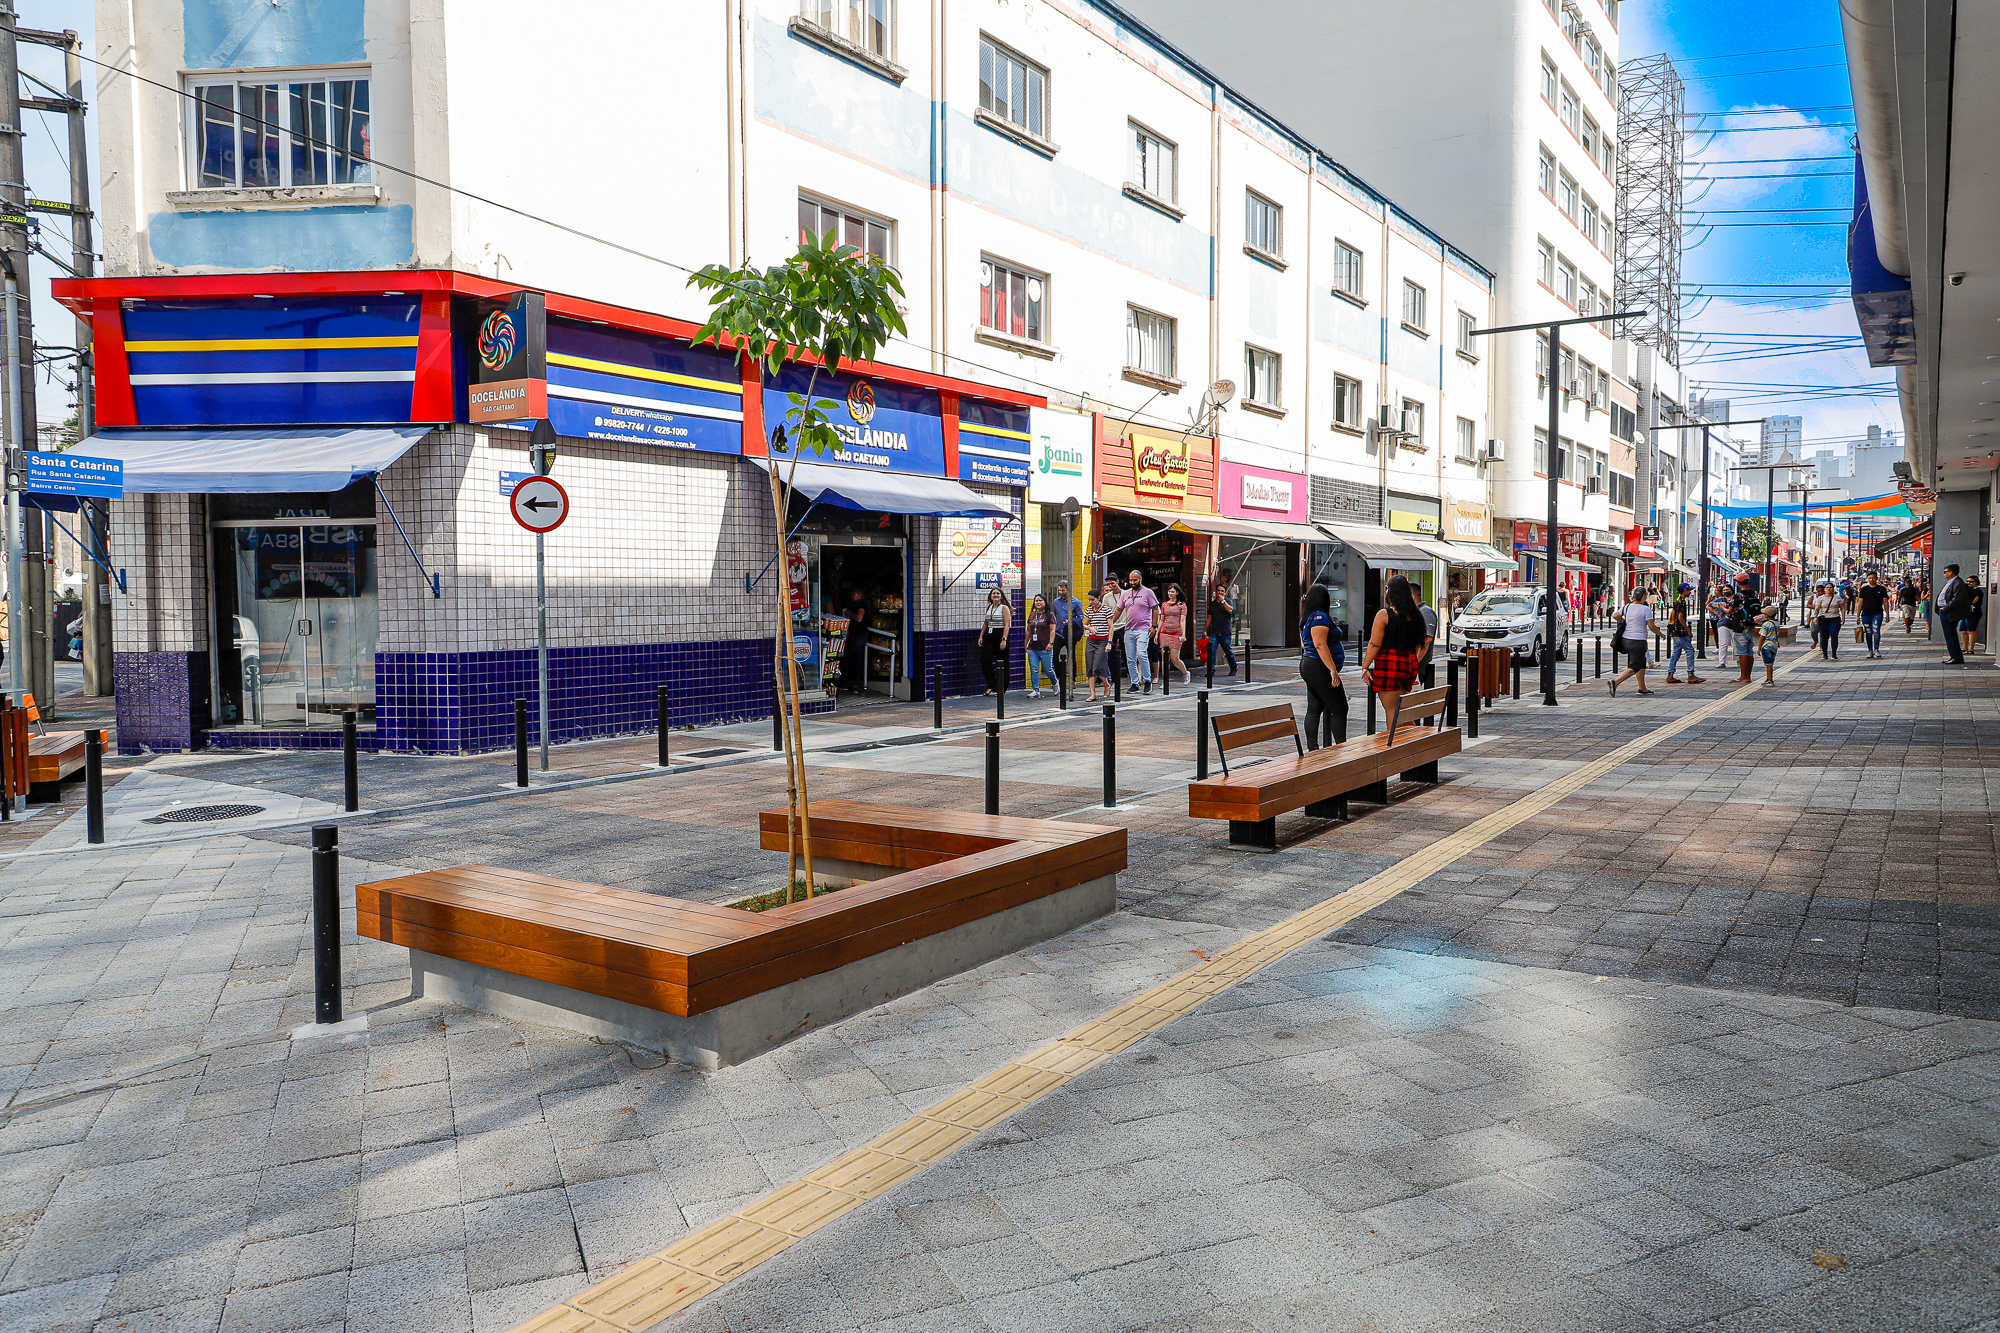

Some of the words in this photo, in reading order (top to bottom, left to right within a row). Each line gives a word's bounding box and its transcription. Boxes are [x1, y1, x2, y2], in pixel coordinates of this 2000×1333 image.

[1214, 382, 1232, 390] SKY
[471, 387, 526, 404] DOCELÂNDIA
[493, 403, 515, 412] CAETANO
[611, 407, 645, 418] DELIVERY:
[603, 418, 645, 432] 99820-7744
[653, 425, 688, 436] 4226-1000
[588, 431, 697, 449] www.docelandiasaocaetano.com.br
[853, 452, 890, 467] CAETANO
[1038, 435, 1083, 474] Joanin
[1143, 449, 1162, 468] Meu
[1163, 452, 1189, 475] Garoto
[31, 456, 67, 467] Santa
[70, 459, 120, 472] Catarina
[74, 473, 106, 481] Catarina
[1246, 483, 1269, 501] Modas
